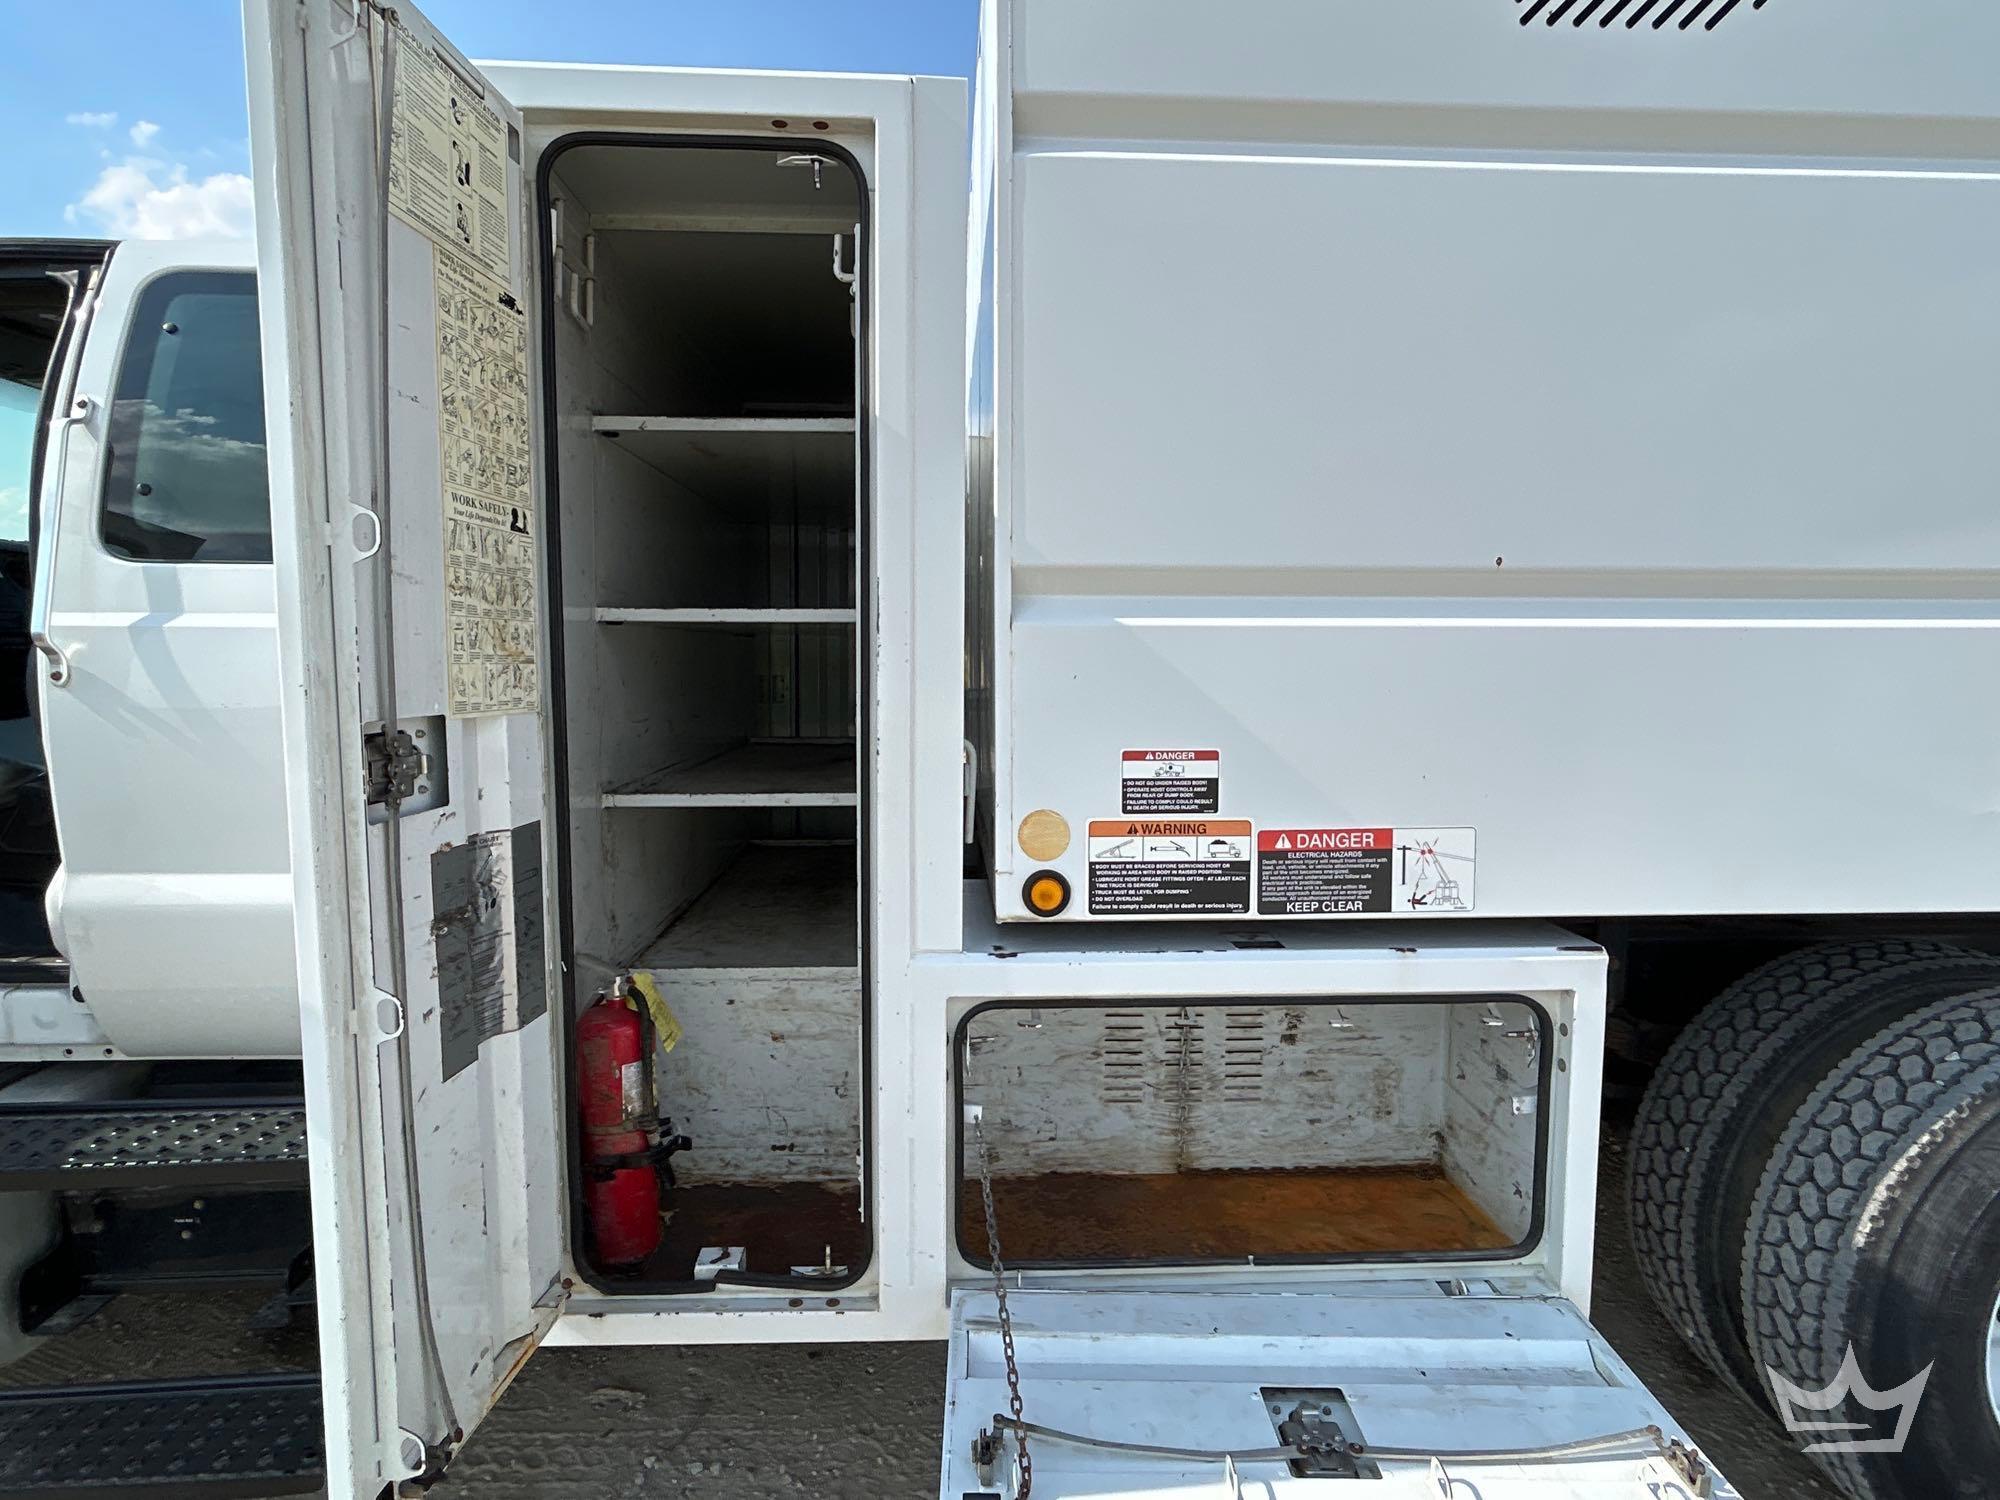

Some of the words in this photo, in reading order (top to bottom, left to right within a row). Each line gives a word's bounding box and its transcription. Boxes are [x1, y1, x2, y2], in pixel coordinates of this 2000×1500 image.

[451, 492, 477, 509] WORK
[453, 507, 465, 516] Your
[465, 510, 474, 519] Life
[1155, 752, 1195, 760] DANGER
[1141, 824, 1207, 835] WARNING
[1297, 832, 1374, 849] DANGER
[1286, 902, 1319, 912] KEEP
[1322, 901, 1363, 911] CLEAR
